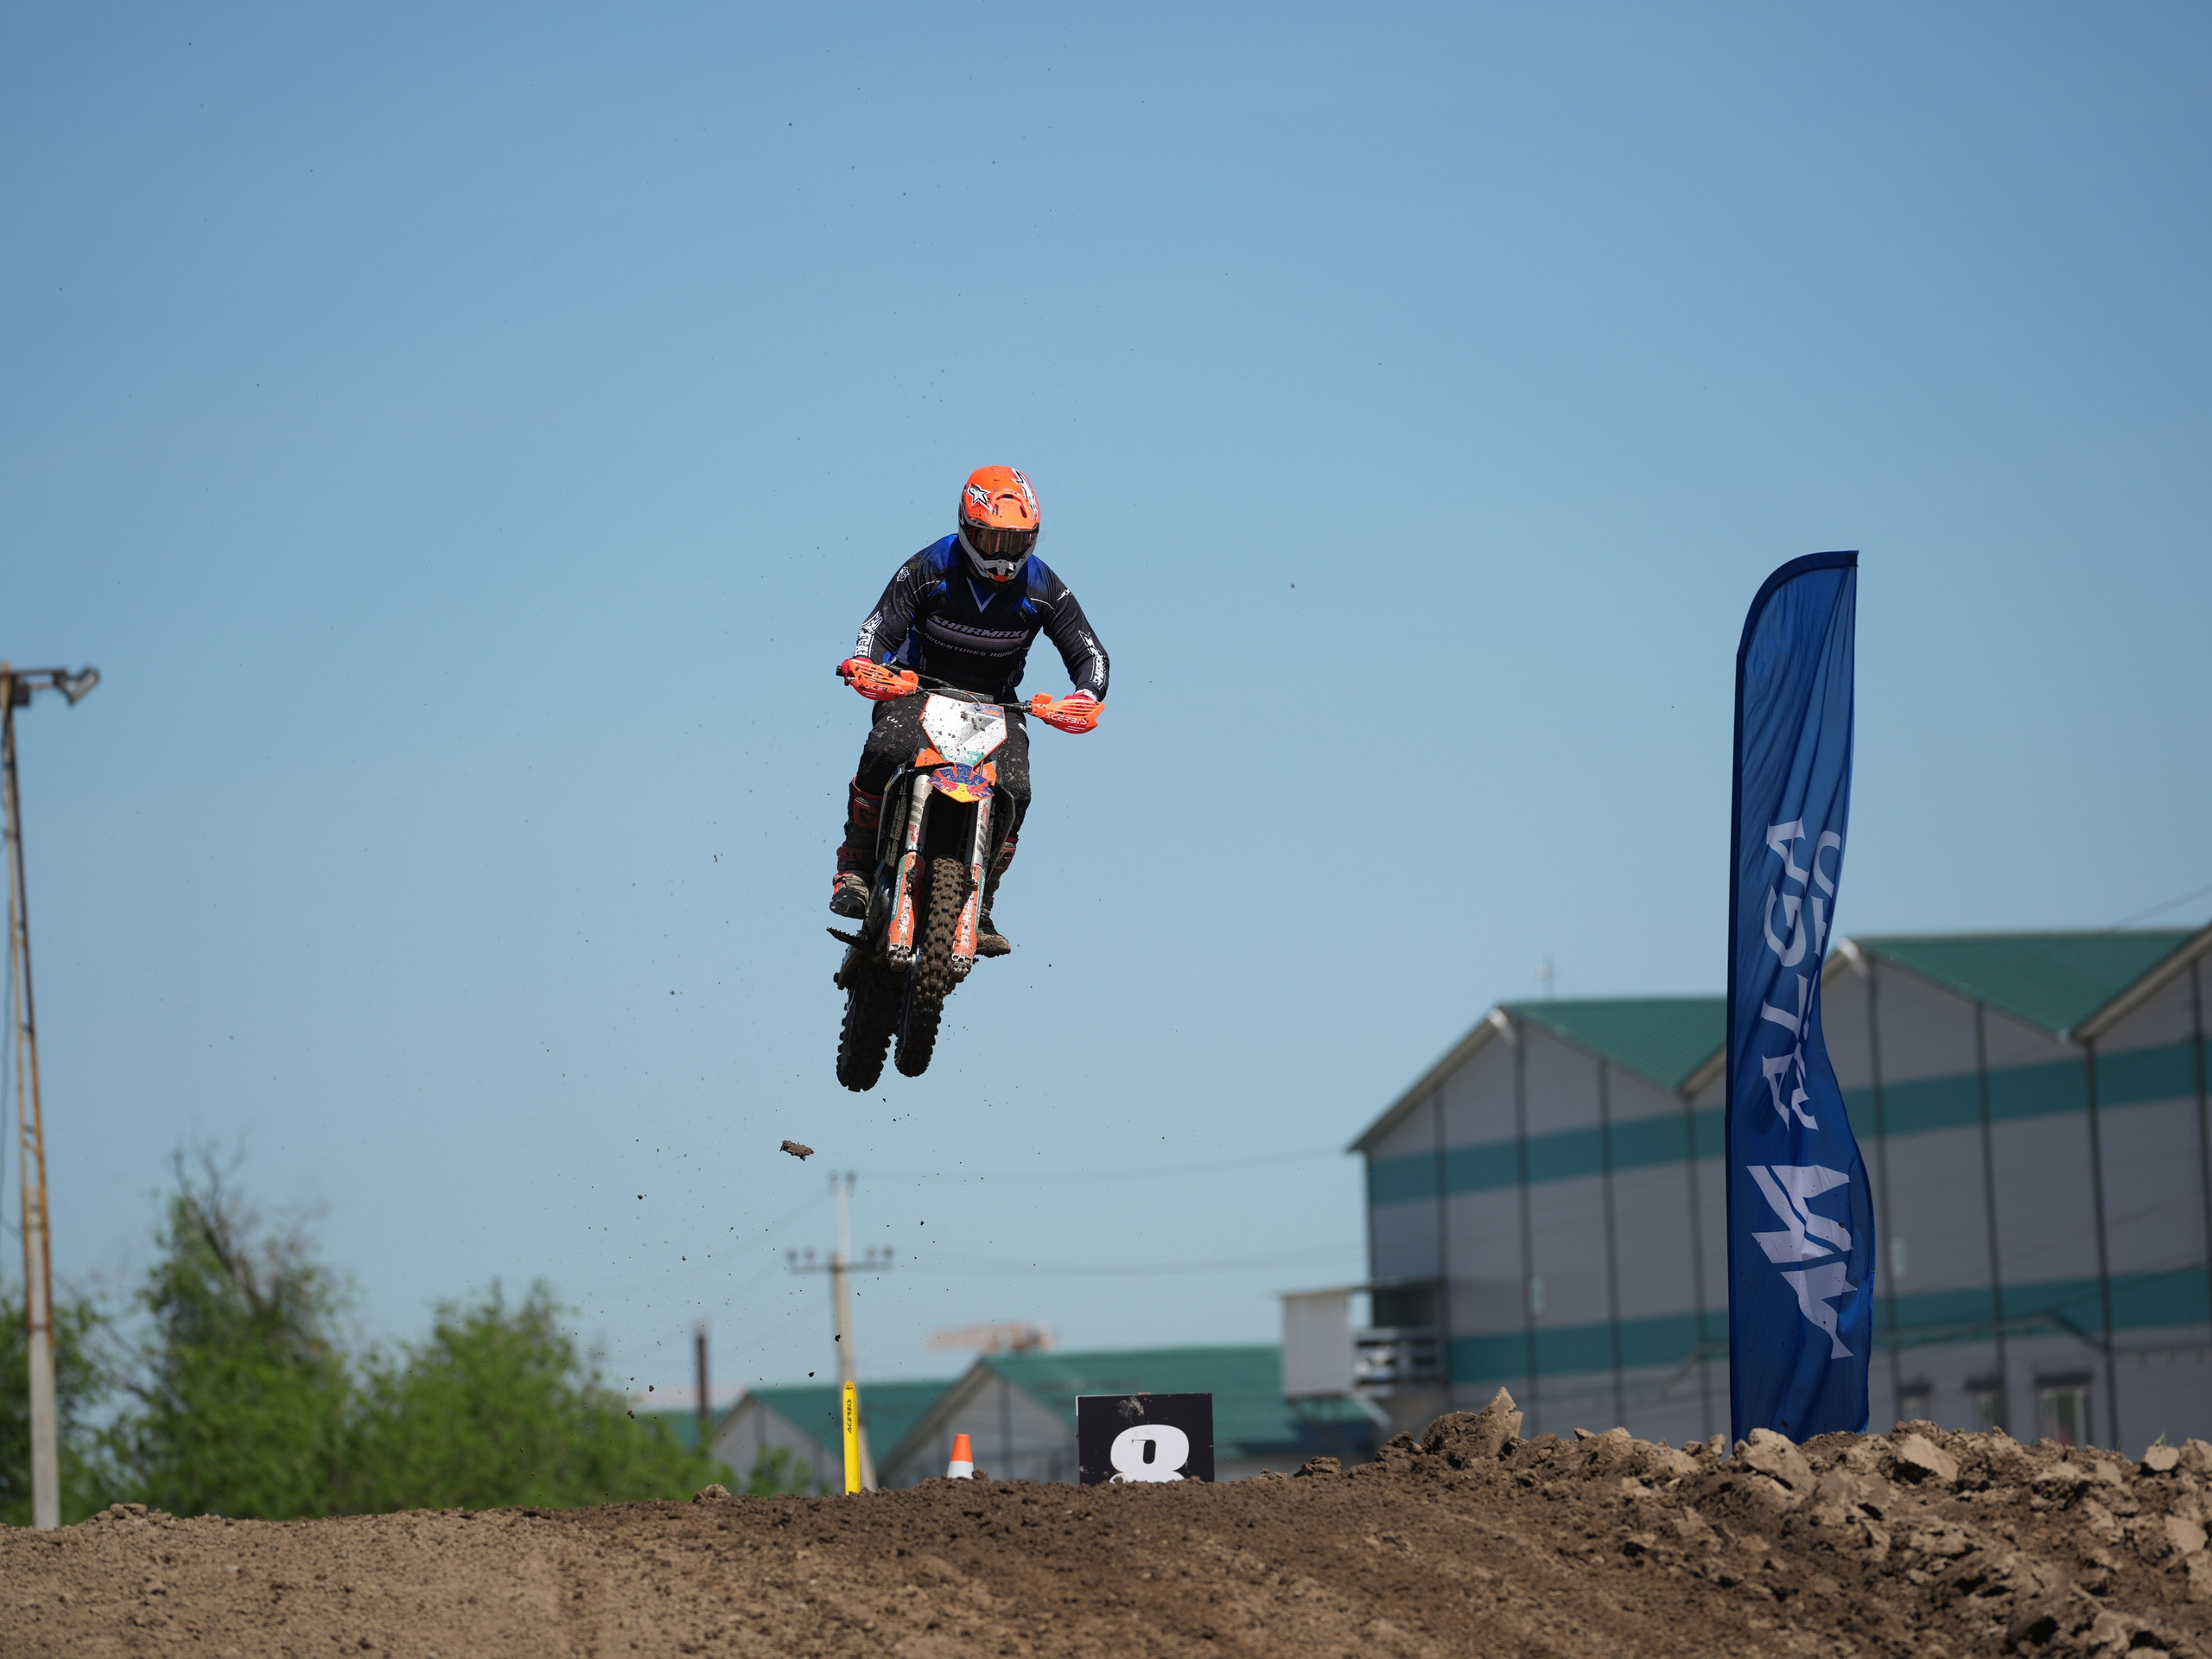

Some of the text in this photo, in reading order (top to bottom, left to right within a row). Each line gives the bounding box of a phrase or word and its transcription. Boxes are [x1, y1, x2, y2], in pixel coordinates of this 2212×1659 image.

[930, 614, 1023, 639] SHARMAX
[924, 632, 988, 657] ADVENTURES
[1043, 712, 1088, 726] ACERBIS
[1760, 816, 1810, 1134] ALGA
